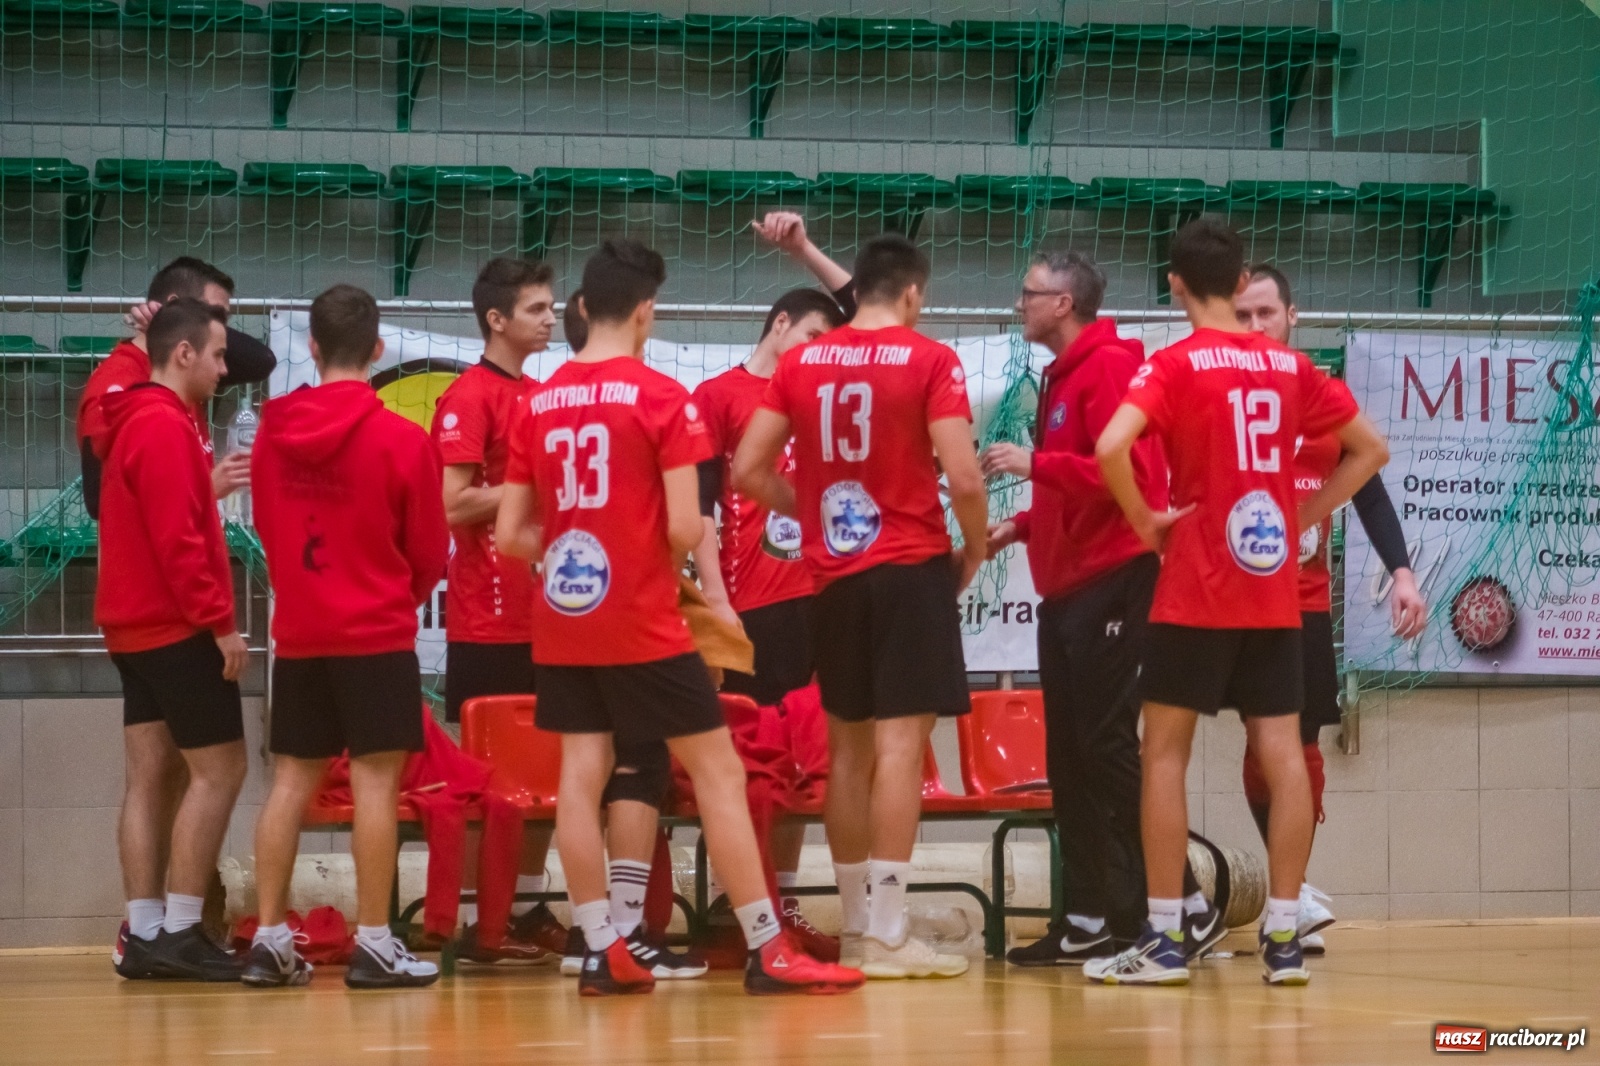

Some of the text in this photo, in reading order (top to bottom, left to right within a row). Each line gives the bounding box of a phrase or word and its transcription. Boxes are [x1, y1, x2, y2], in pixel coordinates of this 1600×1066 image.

[800, 345, 912, 367] VOLLEYBALL TEAM
[1188, 346, 1298, 376] VOLLEYBALL TEAM
[530, 381, 639, 416] VOLLEYBALL TEAM
[1401, 354, 1600, 426] MIES
[816, 382, 873, 463] 13
[1227, 387, 1281, 473] 12
[544, 423, 609, 512] 33
[1419, 448, 1497, 465] poszukuje
[1403, 474, 1506, 497] Operator
[1404, 502, 1521, 524] Pracownik
[1538, 609, 1582, 622] 47-400
[1538, 627, 1559, 639] tel.
[1564, 628, 1590, 640] 032
